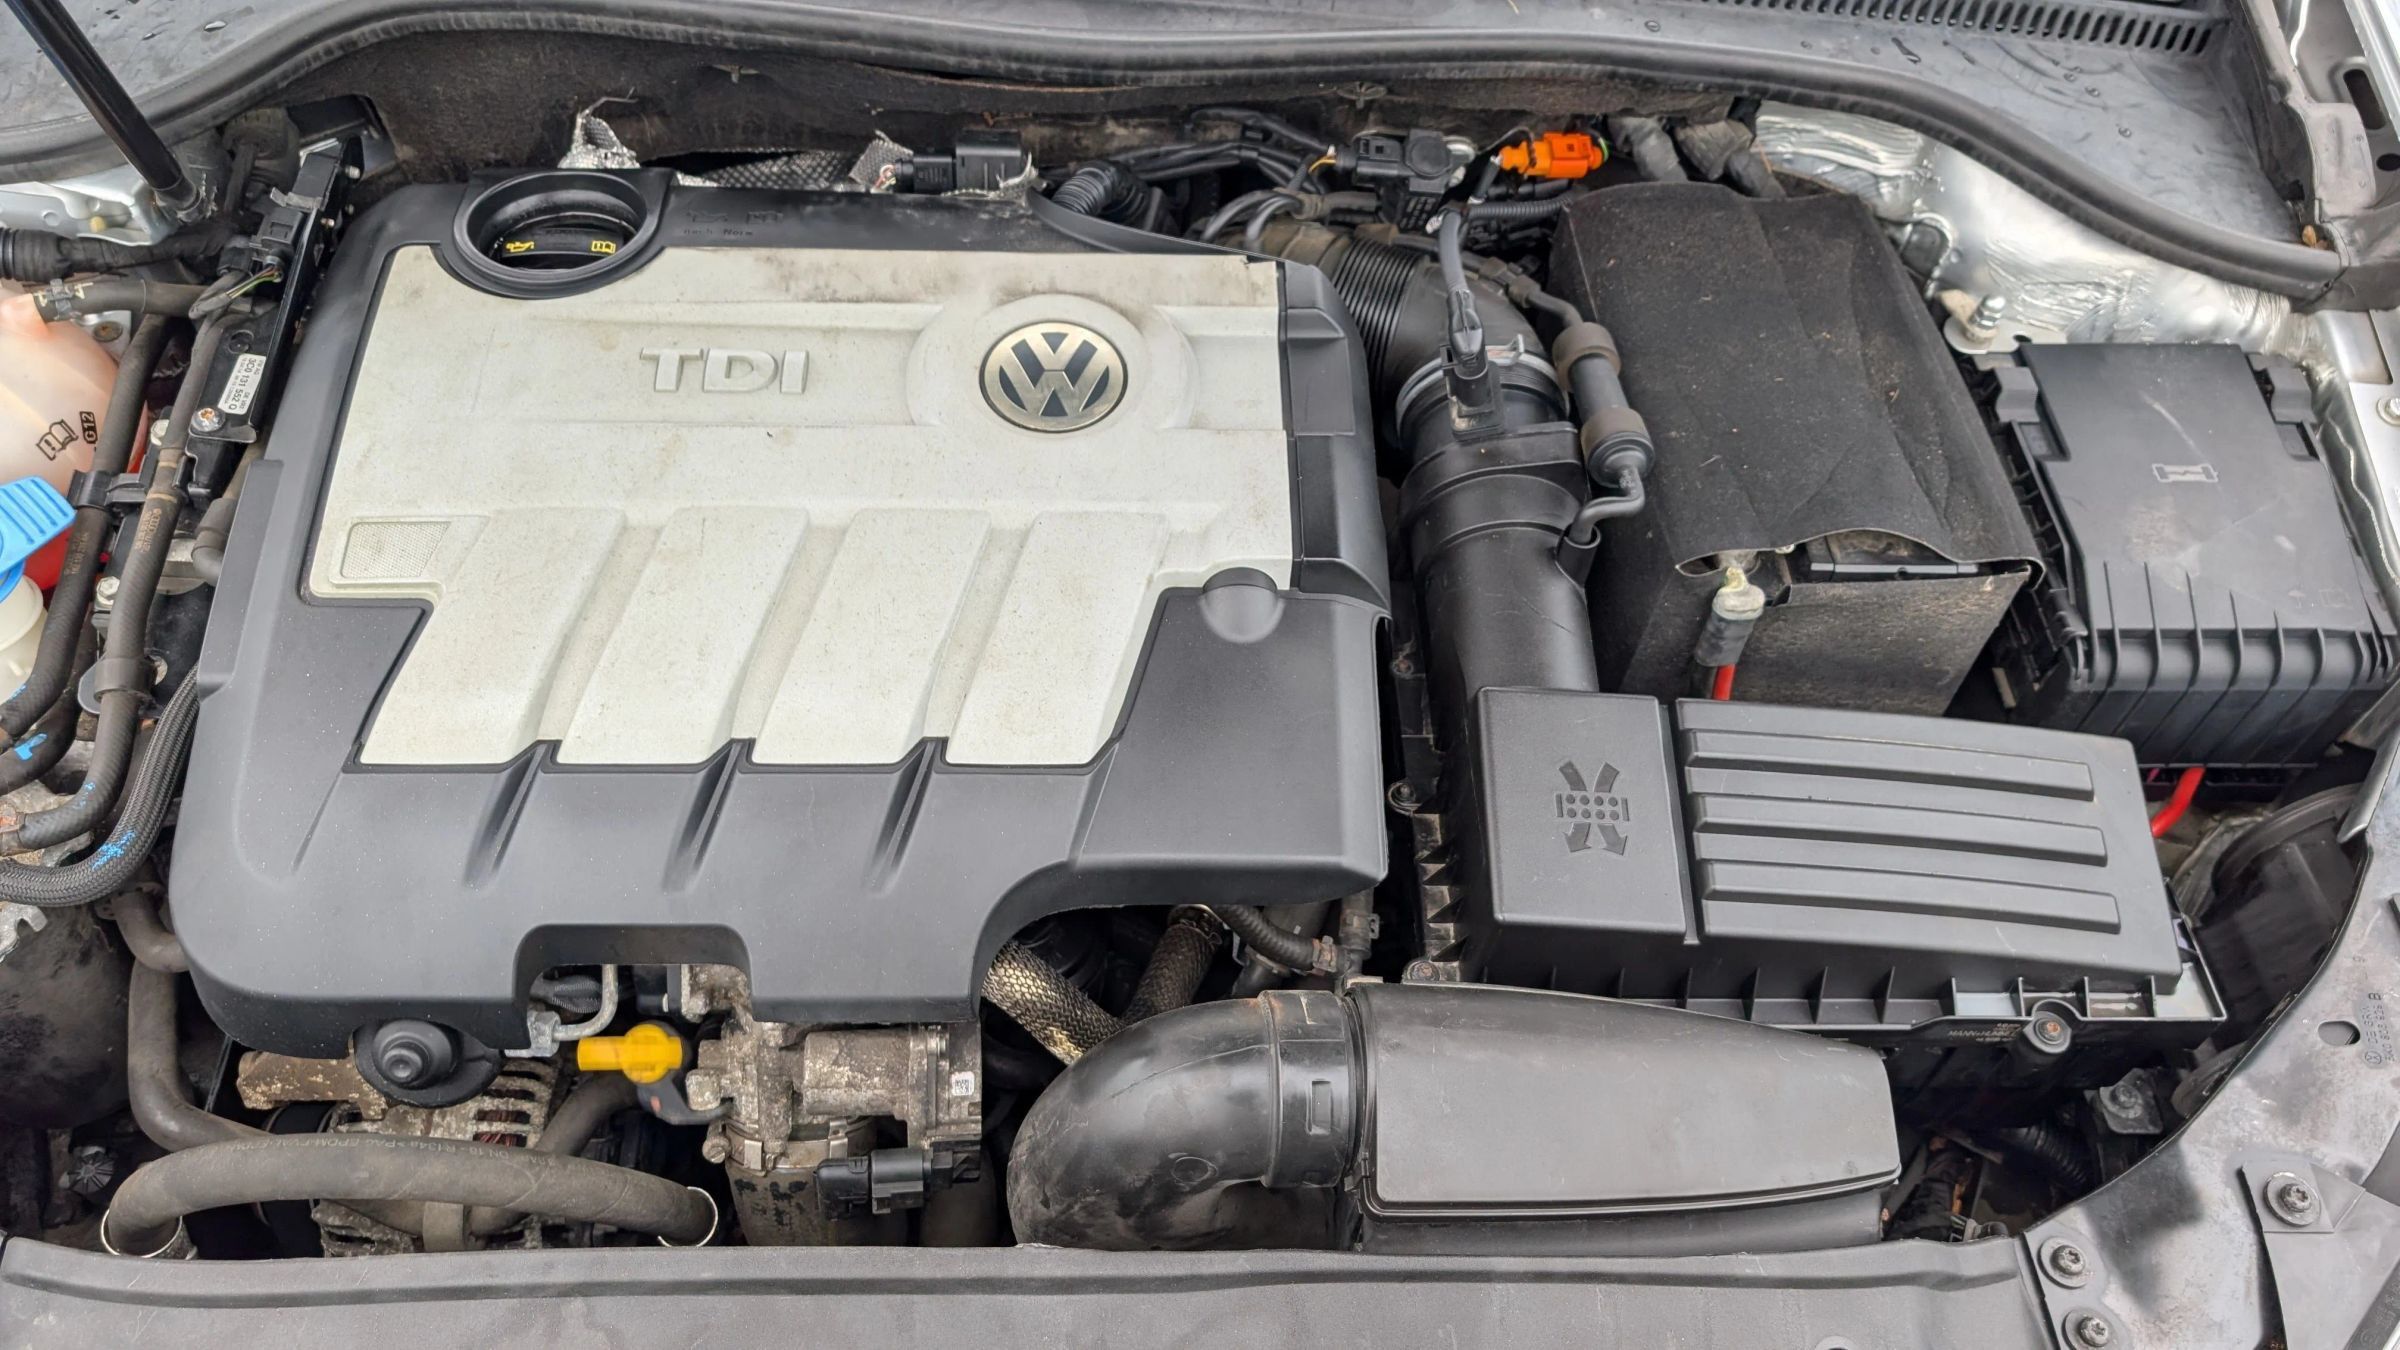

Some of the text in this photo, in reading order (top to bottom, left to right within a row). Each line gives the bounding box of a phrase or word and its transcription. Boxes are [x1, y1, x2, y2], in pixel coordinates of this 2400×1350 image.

[238, 374, 250, 387] 131
[640, 347, 809, 395] TDI
[978, 321, 1129, 433] VW
[231, 388, 243, 402] 552
[82, 413, 97, 442] G12
